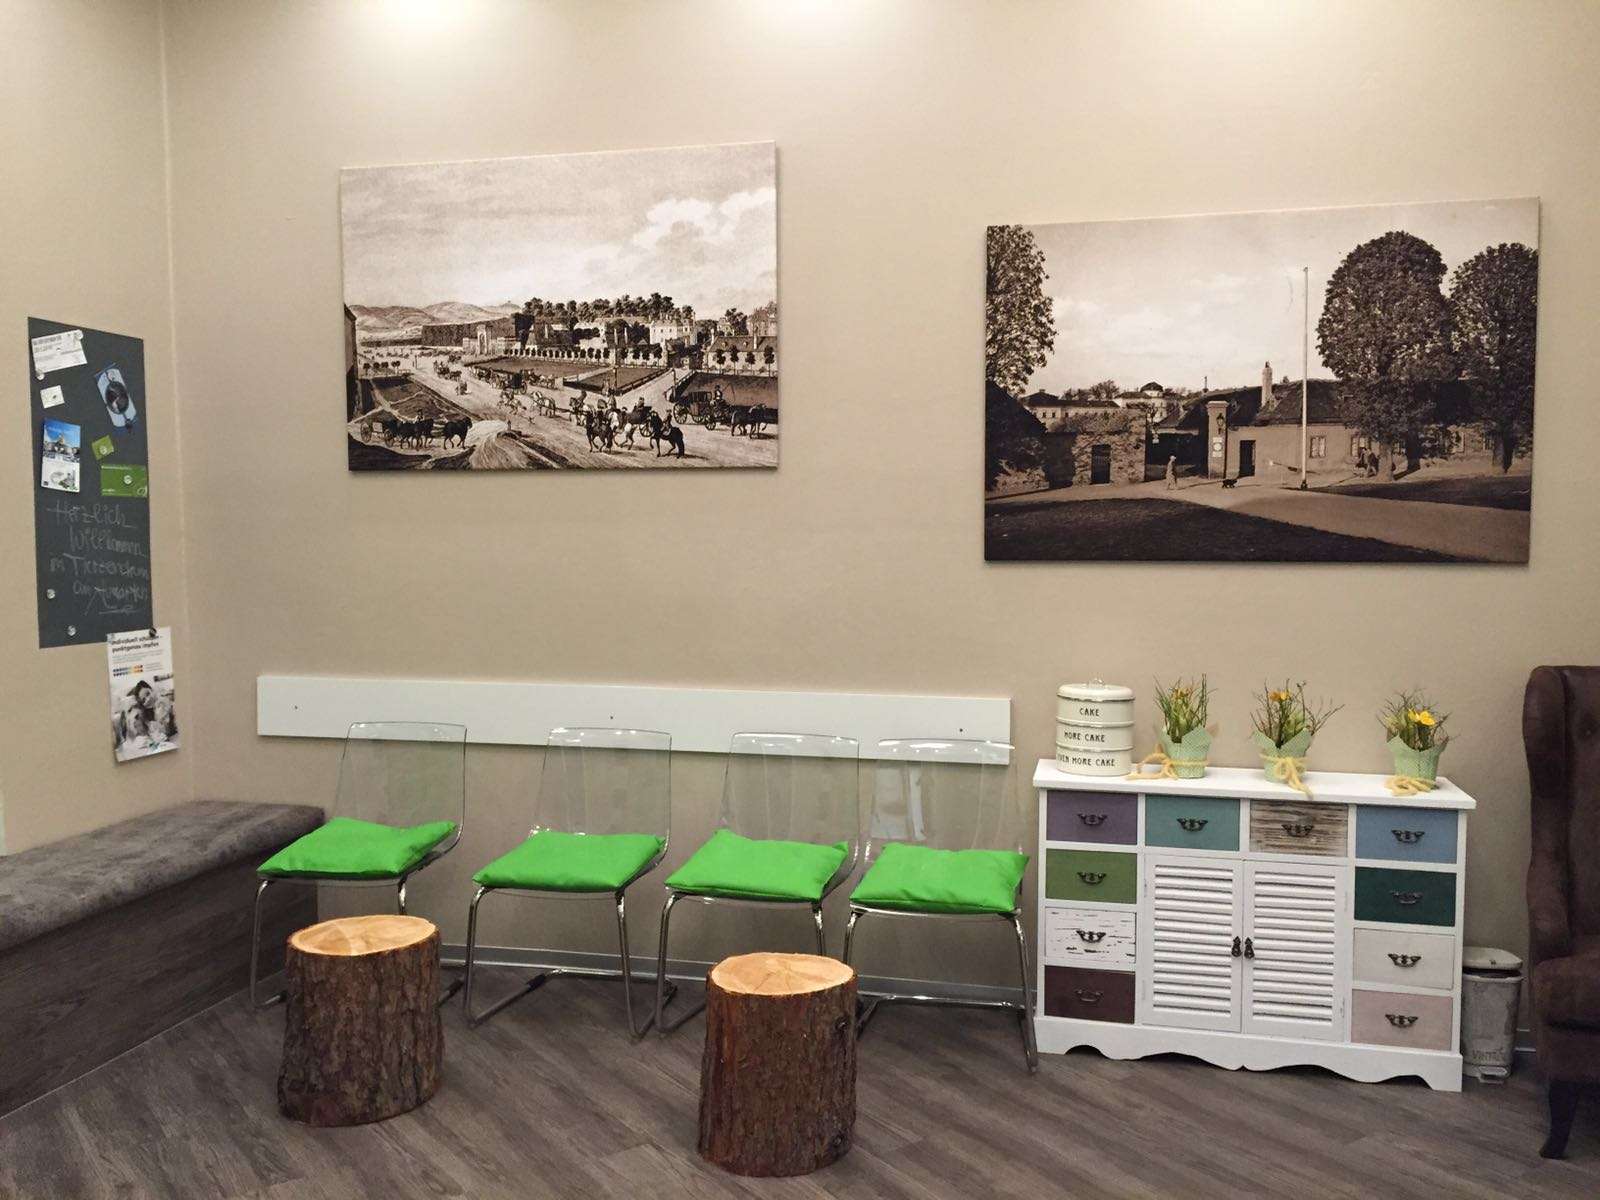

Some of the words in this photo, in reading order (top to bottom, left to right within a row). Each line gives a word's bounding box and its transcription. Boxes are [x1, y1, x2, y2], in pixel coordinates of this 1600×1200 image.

[1079, 708, 1100, 717] CAKE
[1064, 732, 1081, 741] MORE
[1084, 734, 1105, 743] CAKE
[1072, 757, 1092, 766] MORE
[1095, 758, 1116, 767] CAKE
